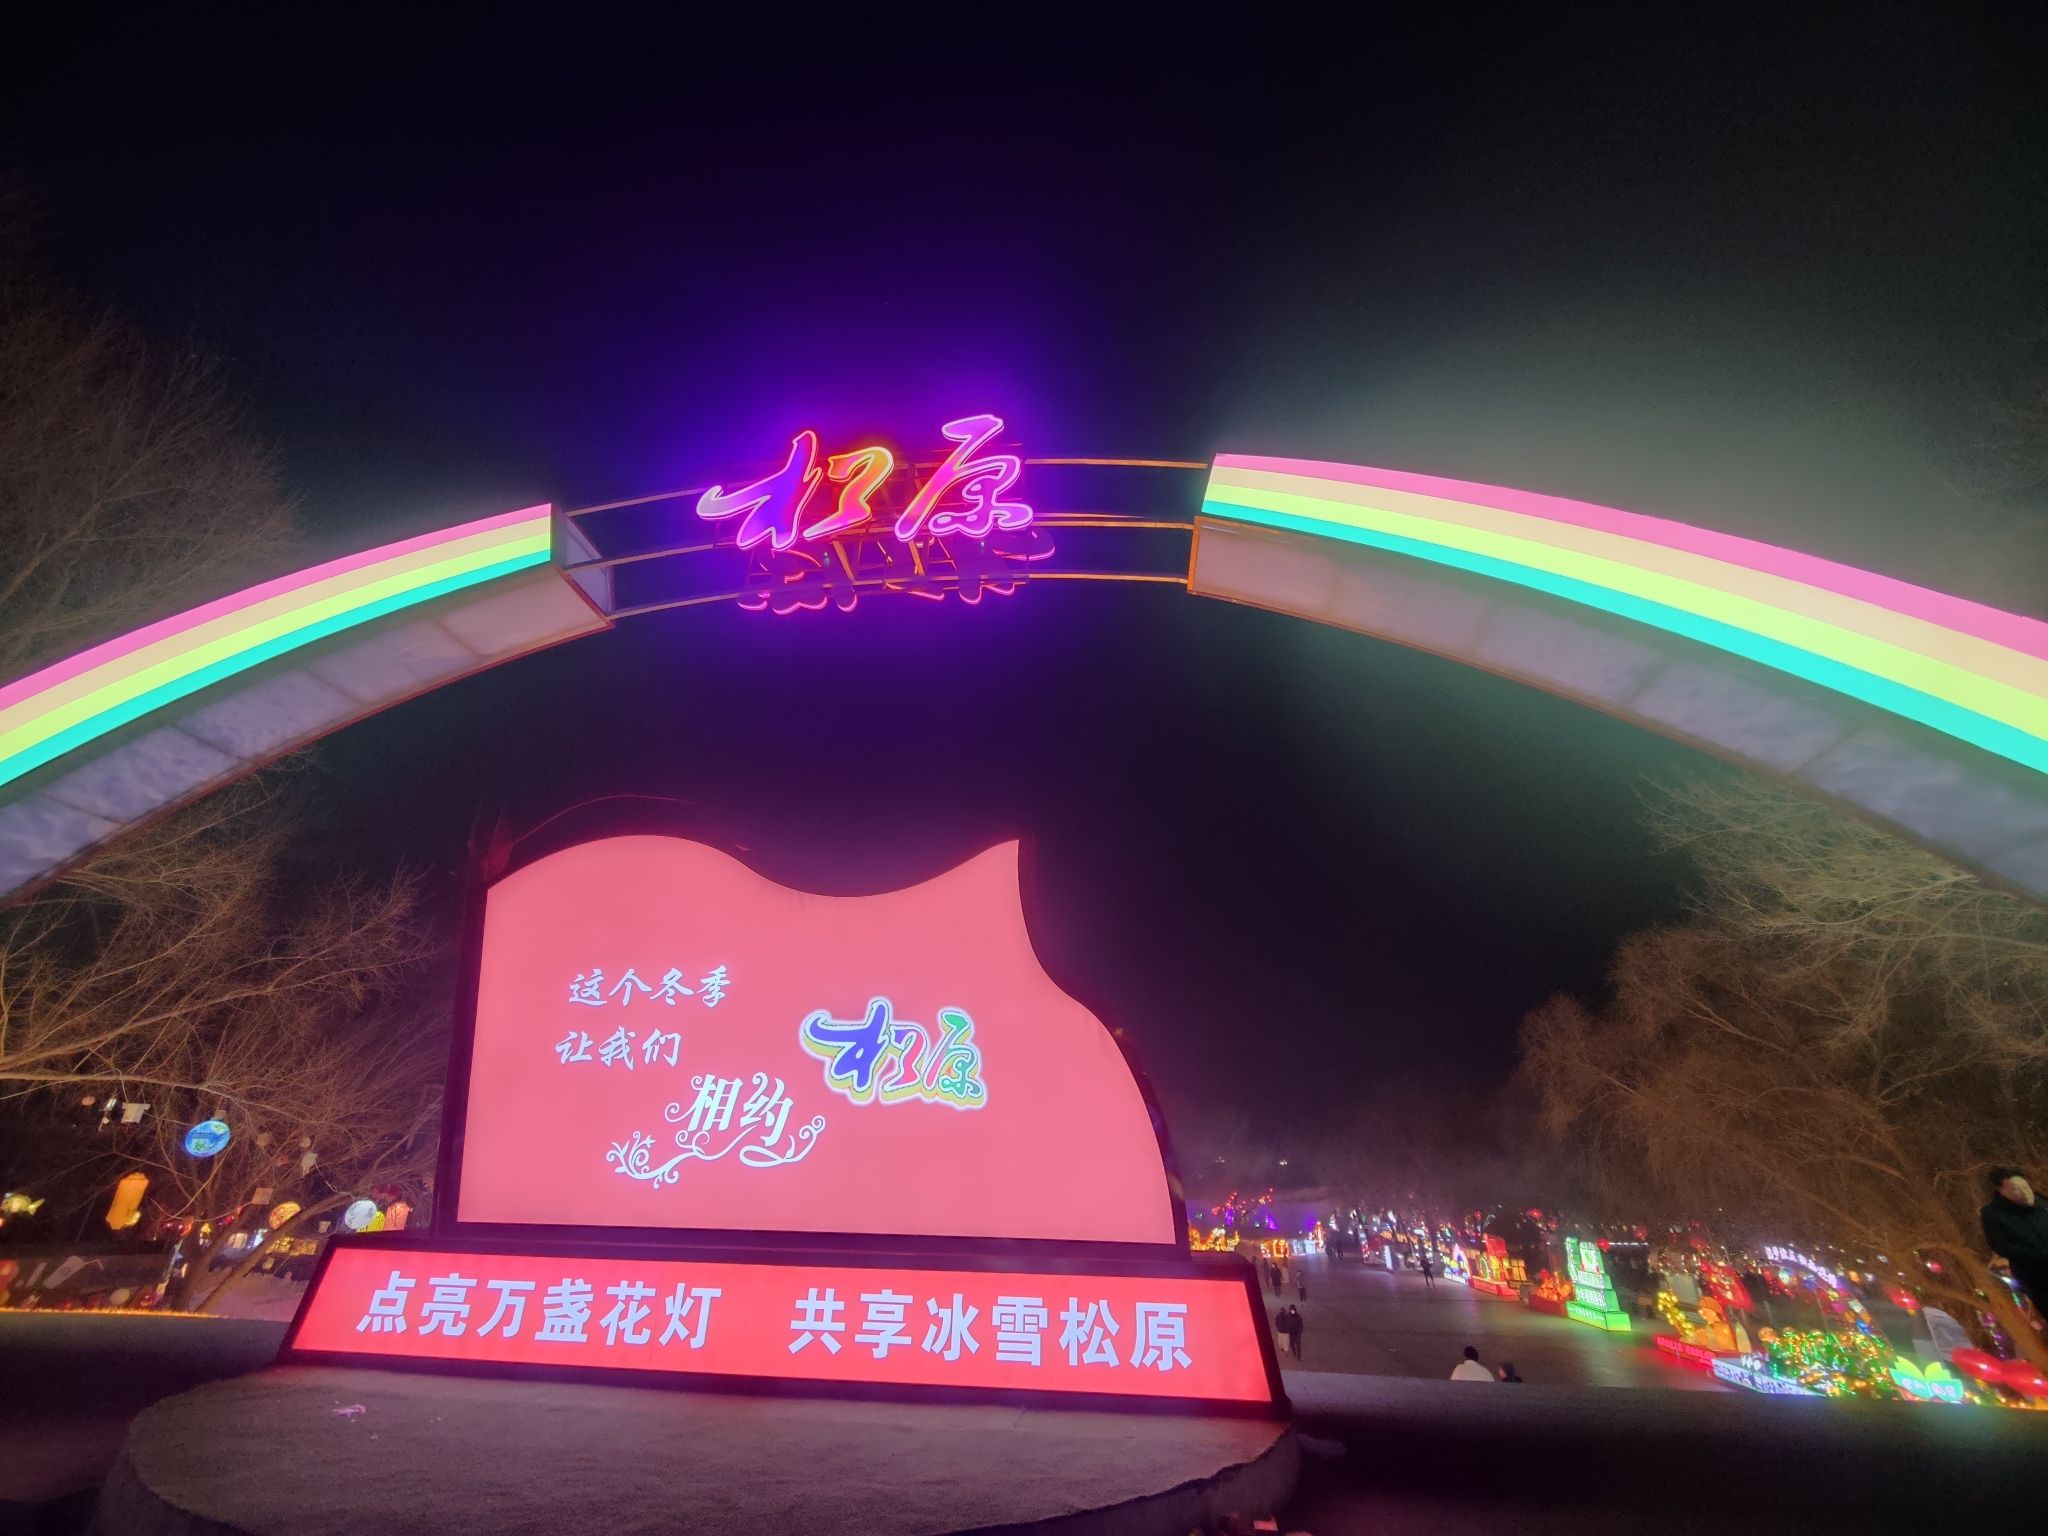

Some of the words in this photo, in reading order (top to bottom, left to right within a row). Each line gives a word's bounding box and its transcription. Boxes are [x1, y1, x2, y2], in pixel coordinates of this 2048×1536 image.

[568, 965, 731, 1008] 这个冬季
[555, 1025, 682, 1071] 让我们
[665, 1072, 795, 1148] 相约
[355, 1270, 722, 1349] 点亮万盏花灯
[788, 1287, 1193, 1371] 共享冰雪松原
